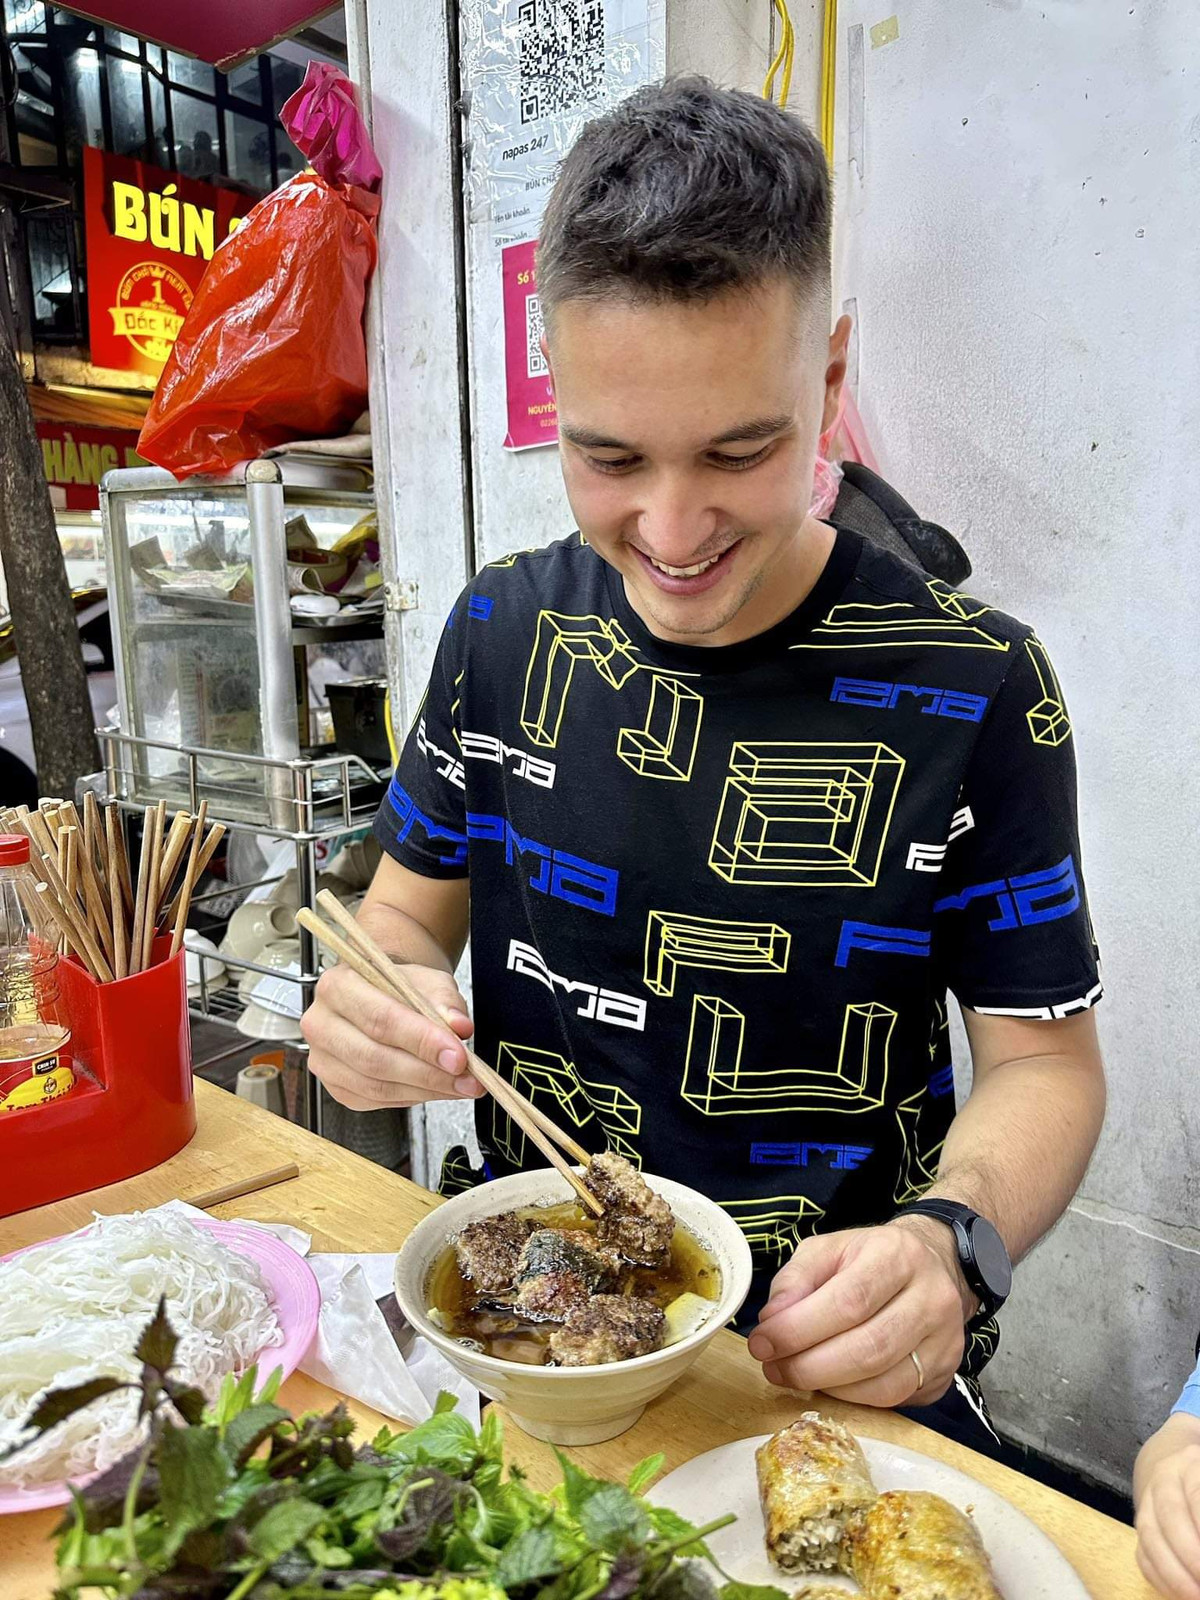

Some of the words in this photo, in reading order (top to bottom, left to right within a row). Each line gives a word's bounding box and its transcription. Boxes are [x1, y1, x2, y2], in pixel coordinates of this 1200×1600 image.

[502, 143, 529, 160] napas
[530, 133, 549, 151] 247
[112, 180, 215, 261] BÚN
[41, 431, 119, 486] HÀNG
